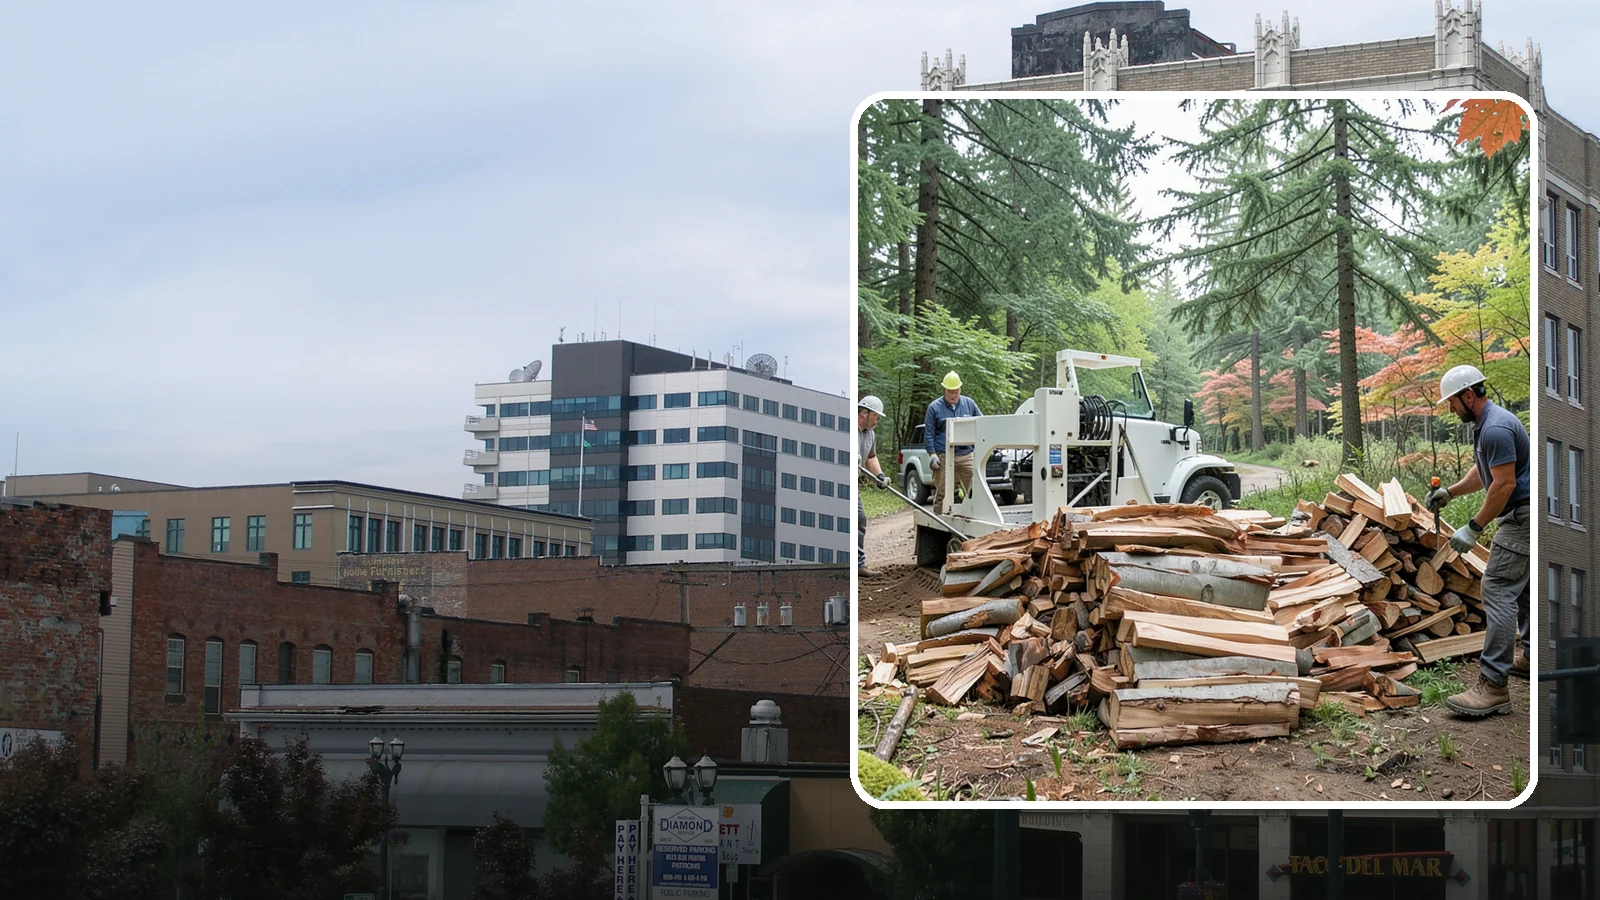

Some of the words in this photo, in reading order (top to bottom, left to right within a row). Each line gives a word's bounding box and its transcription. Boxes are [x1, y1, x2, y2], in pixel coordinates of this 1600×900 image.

[343, 567, 368, 577] Home
[660, 818, 713, 832] DIAMOND
[1021, 815, 1070, 828] BUILDING
[617, 824, 625, 853] PAY
[628, 824, 637, 853] PAY
[656, 845, 688, 853] RESERVED
[689, 846, 716, 854] PARKING
[721, 851, 739, 863] Soup
[671, 861, 701, 870] PATRONS
[1346, 855, 1385, 876] DEL
[1392, 856, 1442, 877] MAR
[616, 855, 625, 894] HERE
[627, 855, 637, 894] HERE
[660, 889, 682, 897] PUBLIC
[683, 889, 710, 898] PARKING
